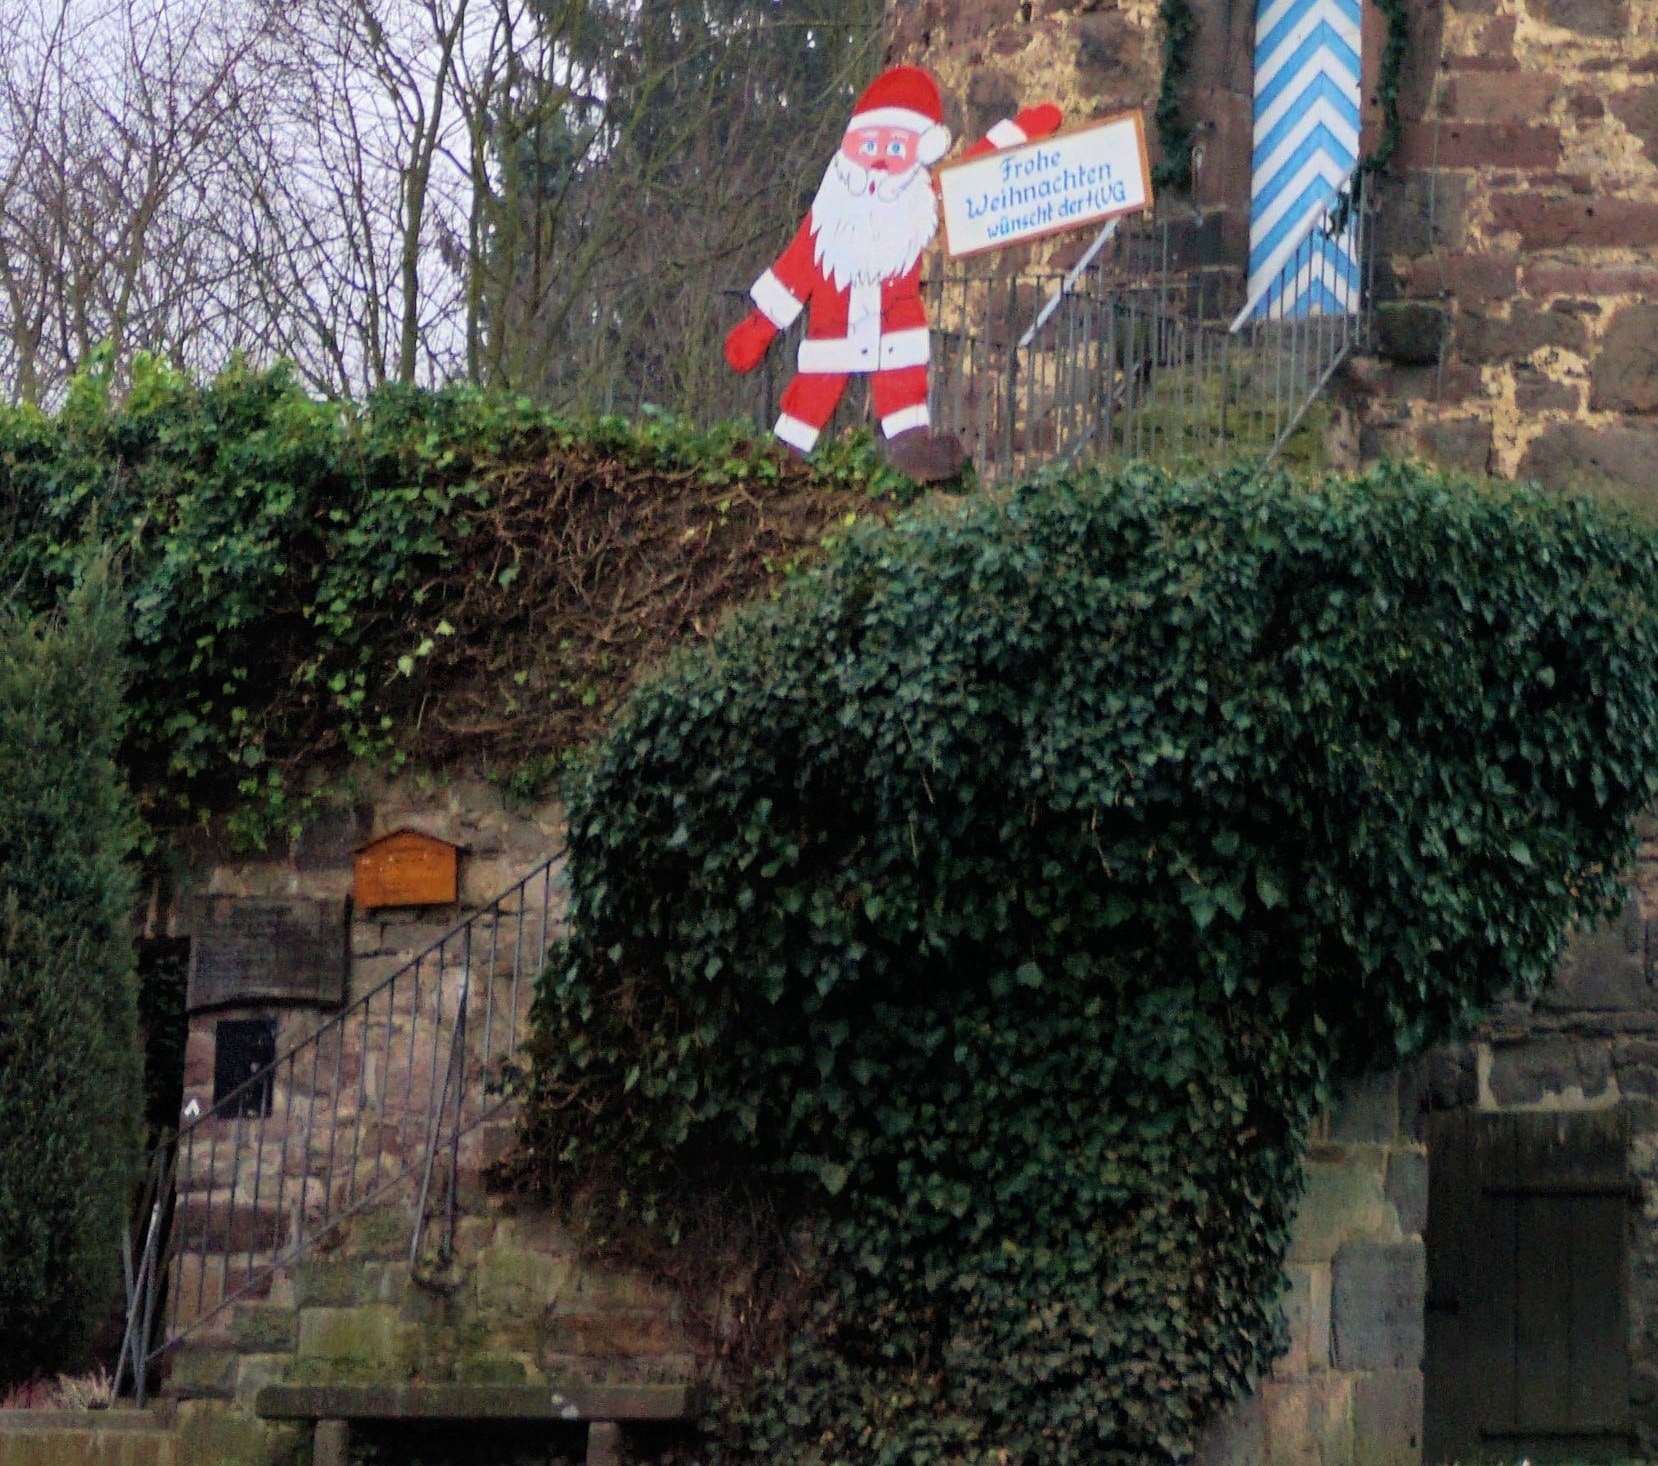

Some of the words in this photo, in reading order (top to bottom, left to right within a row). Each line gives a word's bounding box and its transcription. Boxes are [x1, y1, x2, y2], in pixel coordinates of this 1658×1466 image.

[1001, 149, 1061, 182] Frohe
[966, 162, 1113, 220] Weihnachten
[986, 202, 1054, 240] wünscht
[1058, 196, 1083, 218] der
